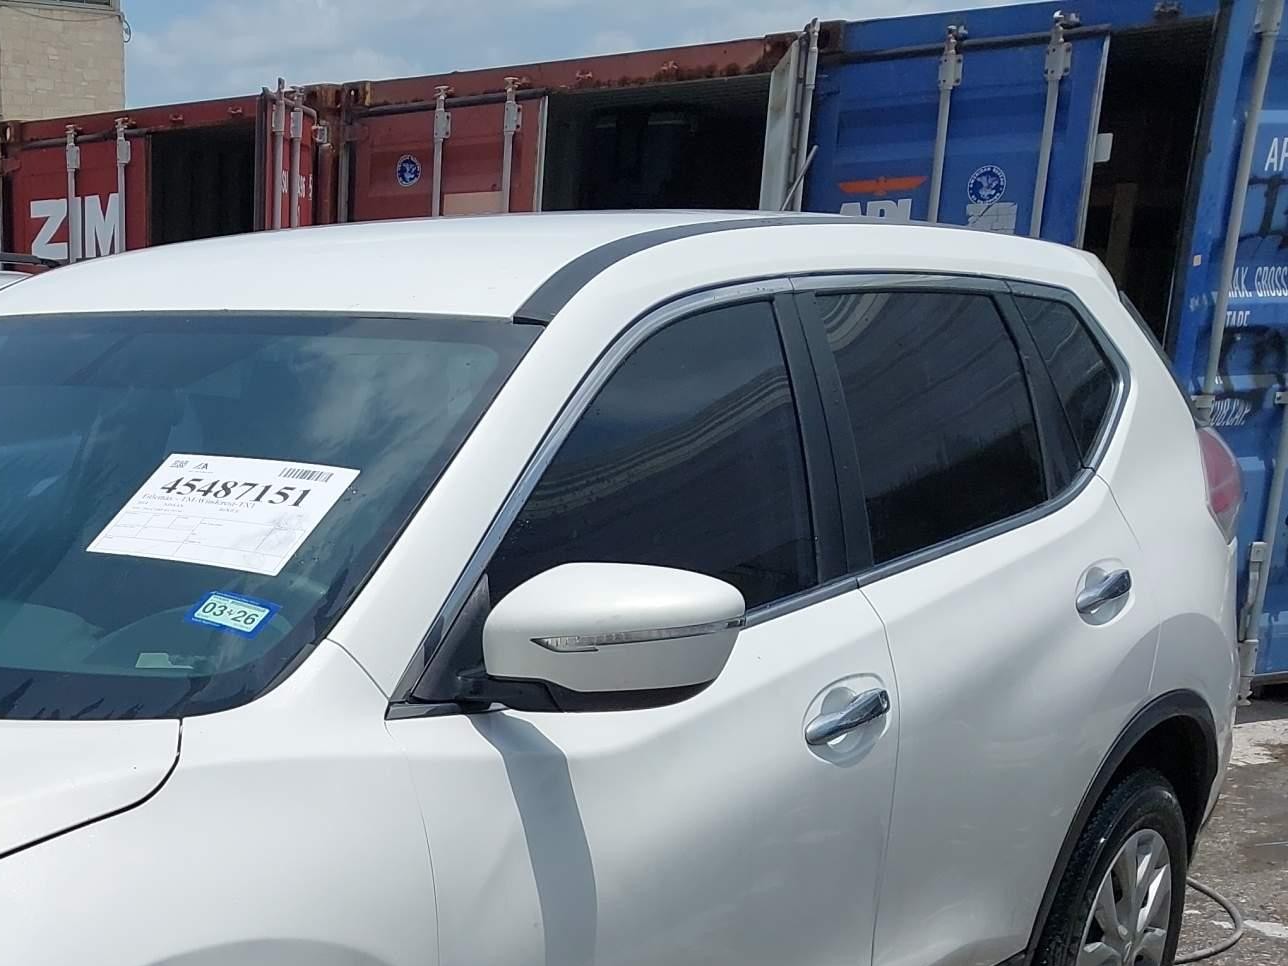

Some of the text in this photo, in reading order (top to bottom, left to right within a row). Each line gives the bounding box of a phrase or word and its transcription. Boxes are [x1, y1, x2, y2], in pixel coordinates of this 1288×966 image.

[30, 193, 120, 260] ZIM
[1254, 266, 1288, 297] GROSS
[160, 477, 312, 507] 45487151
